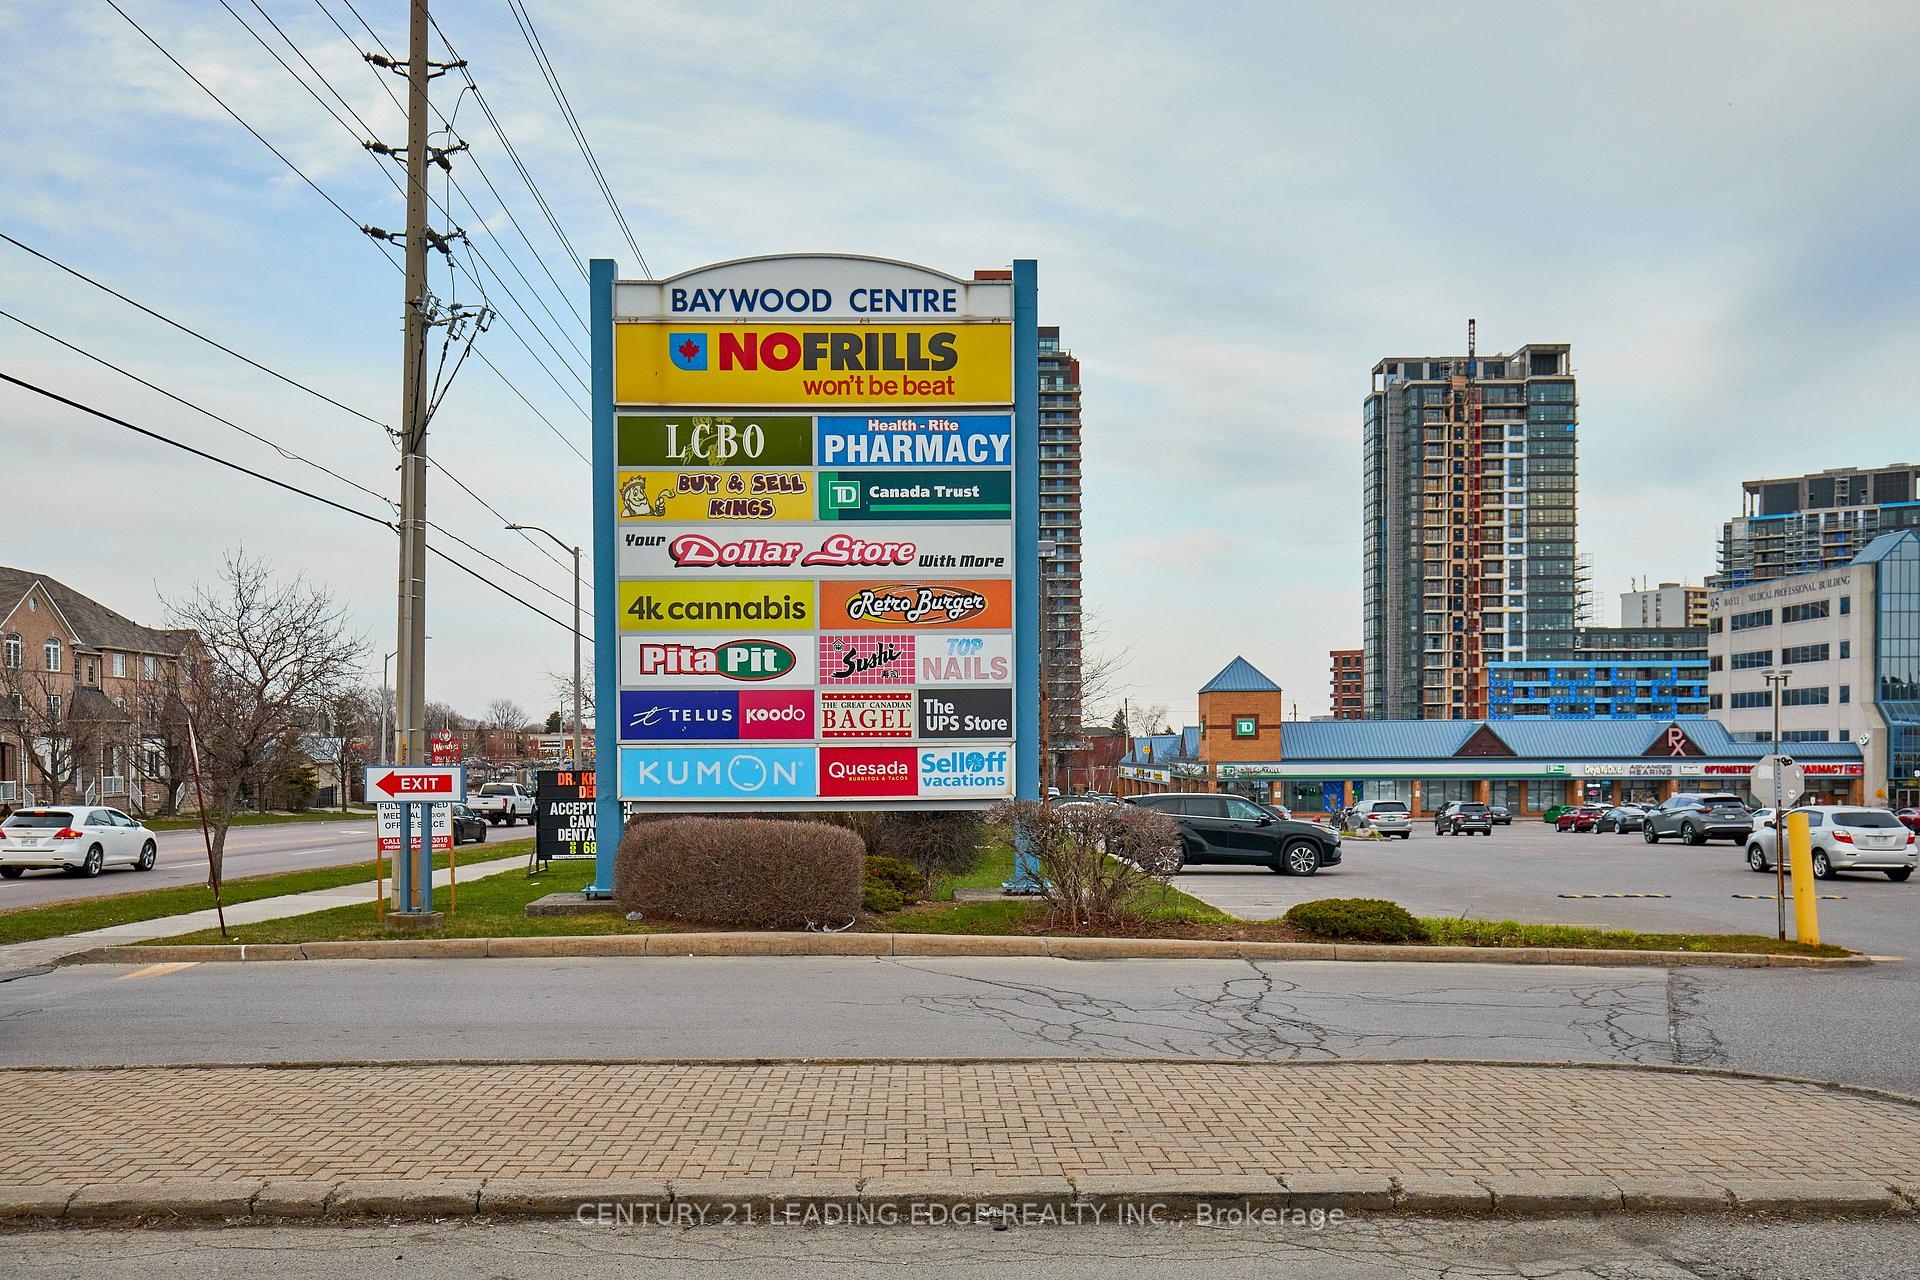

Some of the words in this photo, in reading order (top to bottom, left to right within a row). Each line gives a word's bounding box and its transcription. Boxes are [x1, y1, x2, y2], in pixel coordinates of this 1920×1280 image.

[672, 288, 832, 313] BAYWOOD
[849, 288, 957, 313] CENTRE
[803, 375, 864, 396] won't
[869, 375, 898, 396] be
[903, 375, 955, 396] beat
[868, 419, 917, 432] Health
[928, 419, 960, 432] Rite
[665, 424, 765, 459] LCBO
[825, 434, 1010, 463] PHARMACY
[677, 474, 721, 494] BUY
[727, 474, 745, 494] &
[751, 473, 806, 494] SELL
[832, 486, 857, 503] TD
[869, 485, 930, 498] Canada
[933, 485, 980, 498] Trust
[709, 499, 775, 519] KINGS
[625, 534, 666, 546] Your
[671, 534, 802, 566] Dollar
[803, 534, 916, 566] Store
[919, 555, 956, 567] With
[959, 555, 1004, 567] More
[1710, 597, 1720, 612] 95
[1748, 590, 1774, 601] MEDICAL
[1773, 582, 1817, 599] PROFESSIONAL
[1818, 575, 1851, 591] BUILDING
[628, 595, 664, 620] 4k
[667, 595, 806, 620] cannabis
[849, 589, 911, 620] Retro
[905, 588, 985, 622] Burger
[946, 638, 984, 656] TOP
[642, 646, 718, 673] Pita
[727, 646, 779, 673] Pit
[831, 642, 904, 679] Sushi
[922, 656, 1008, 681] NAILS
[669, 709, 733, 722] TELUS
[923, 699, 954, 714] The
[822, 709, 912, 729] BAGEL
[926, 715, 959, 731] UPS
[964, 716, 1008, 731] Store
[1238, 722, 1253, 732] TD
[557, 772, 577, 786] DR.
[581, 772, 597, 786] KH
[639, 755, 797, 791] KUMON
[829, 761, 908, 779] Quesada
[401, 777, 439, 790] EXIT
[923, 774, 1005, 787] vacations
[578, 786, 597, 799] DE
[549, 802, 597, 816] ACCEPTI
[569, 815, 597, 828] CAN
[557, 828, 596, 842] DENTA
[583, 841, 597, 855] 68
